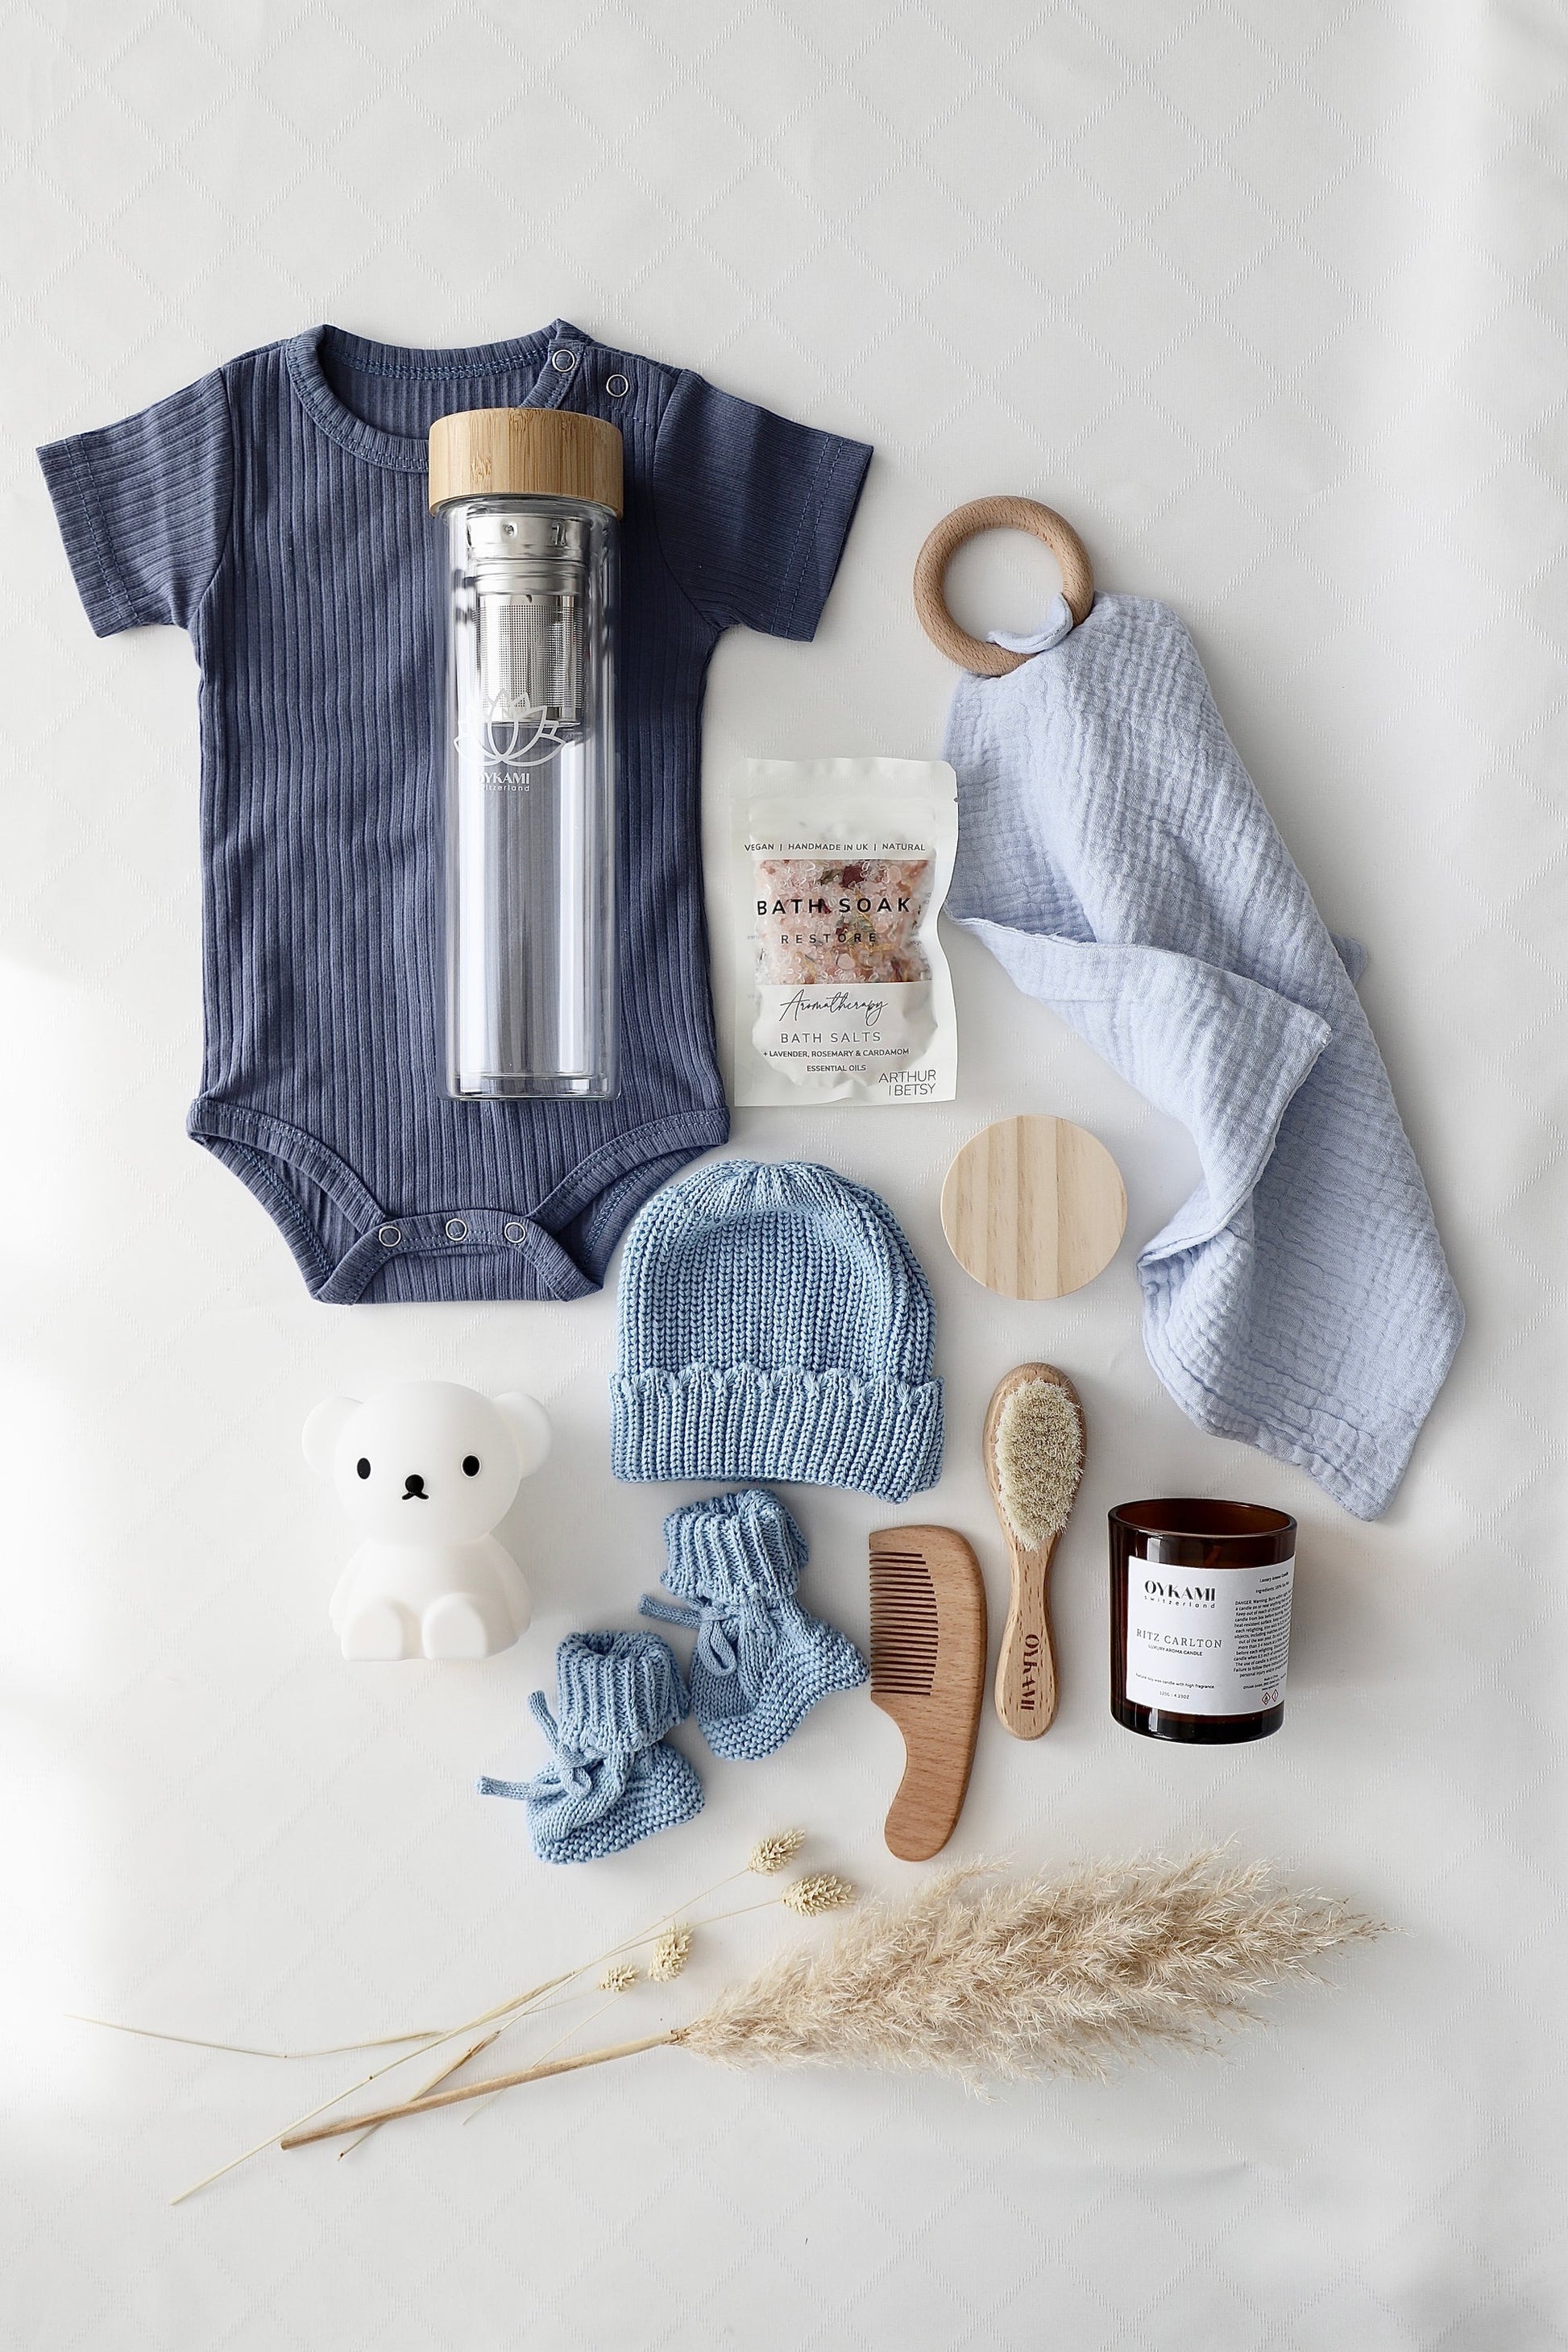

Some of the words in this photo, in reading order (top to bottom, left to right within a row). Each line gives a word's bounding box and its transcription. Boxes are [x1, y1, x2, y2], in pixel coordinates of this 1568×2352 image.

[744, 843, 774, 852] VEGAN
[788, 843, 841, 852] HANDMADE
[844, 843, 853, 851] IN
[856, 843, 869, 851] UK
[881, 843, 926, 852] NATURAL
[757, 898, 823, 916] BATH
[838, 897, 911, 914] SOAK
[781, 932, 877, 944] RESTORE
[778, 989, 888, 1027] Aromatherapy
[780, 1032, 823, 1043] BATH
[830, 1031, 881, 1043] SALTS
[769, 1050, 810, 1059] LAVENDER,
[855, 1049, 861, 1057] &
[862, 1047, 910, 1057] CARDAMOM
[877, 1069, 936, 1084] ARTHUR
[1144, 1579, 1217, 1602] OYKAMI
[1144, 1595, 1216, 1609] switzerland
[1135, 1628, 1159, 1643] RITZ
[1164, 1634, 1223, 1649] CARLTON
[1147, 1644, 1165, 1652] LUXURY
[1165, 1647, 1183, 1655] AROMA
